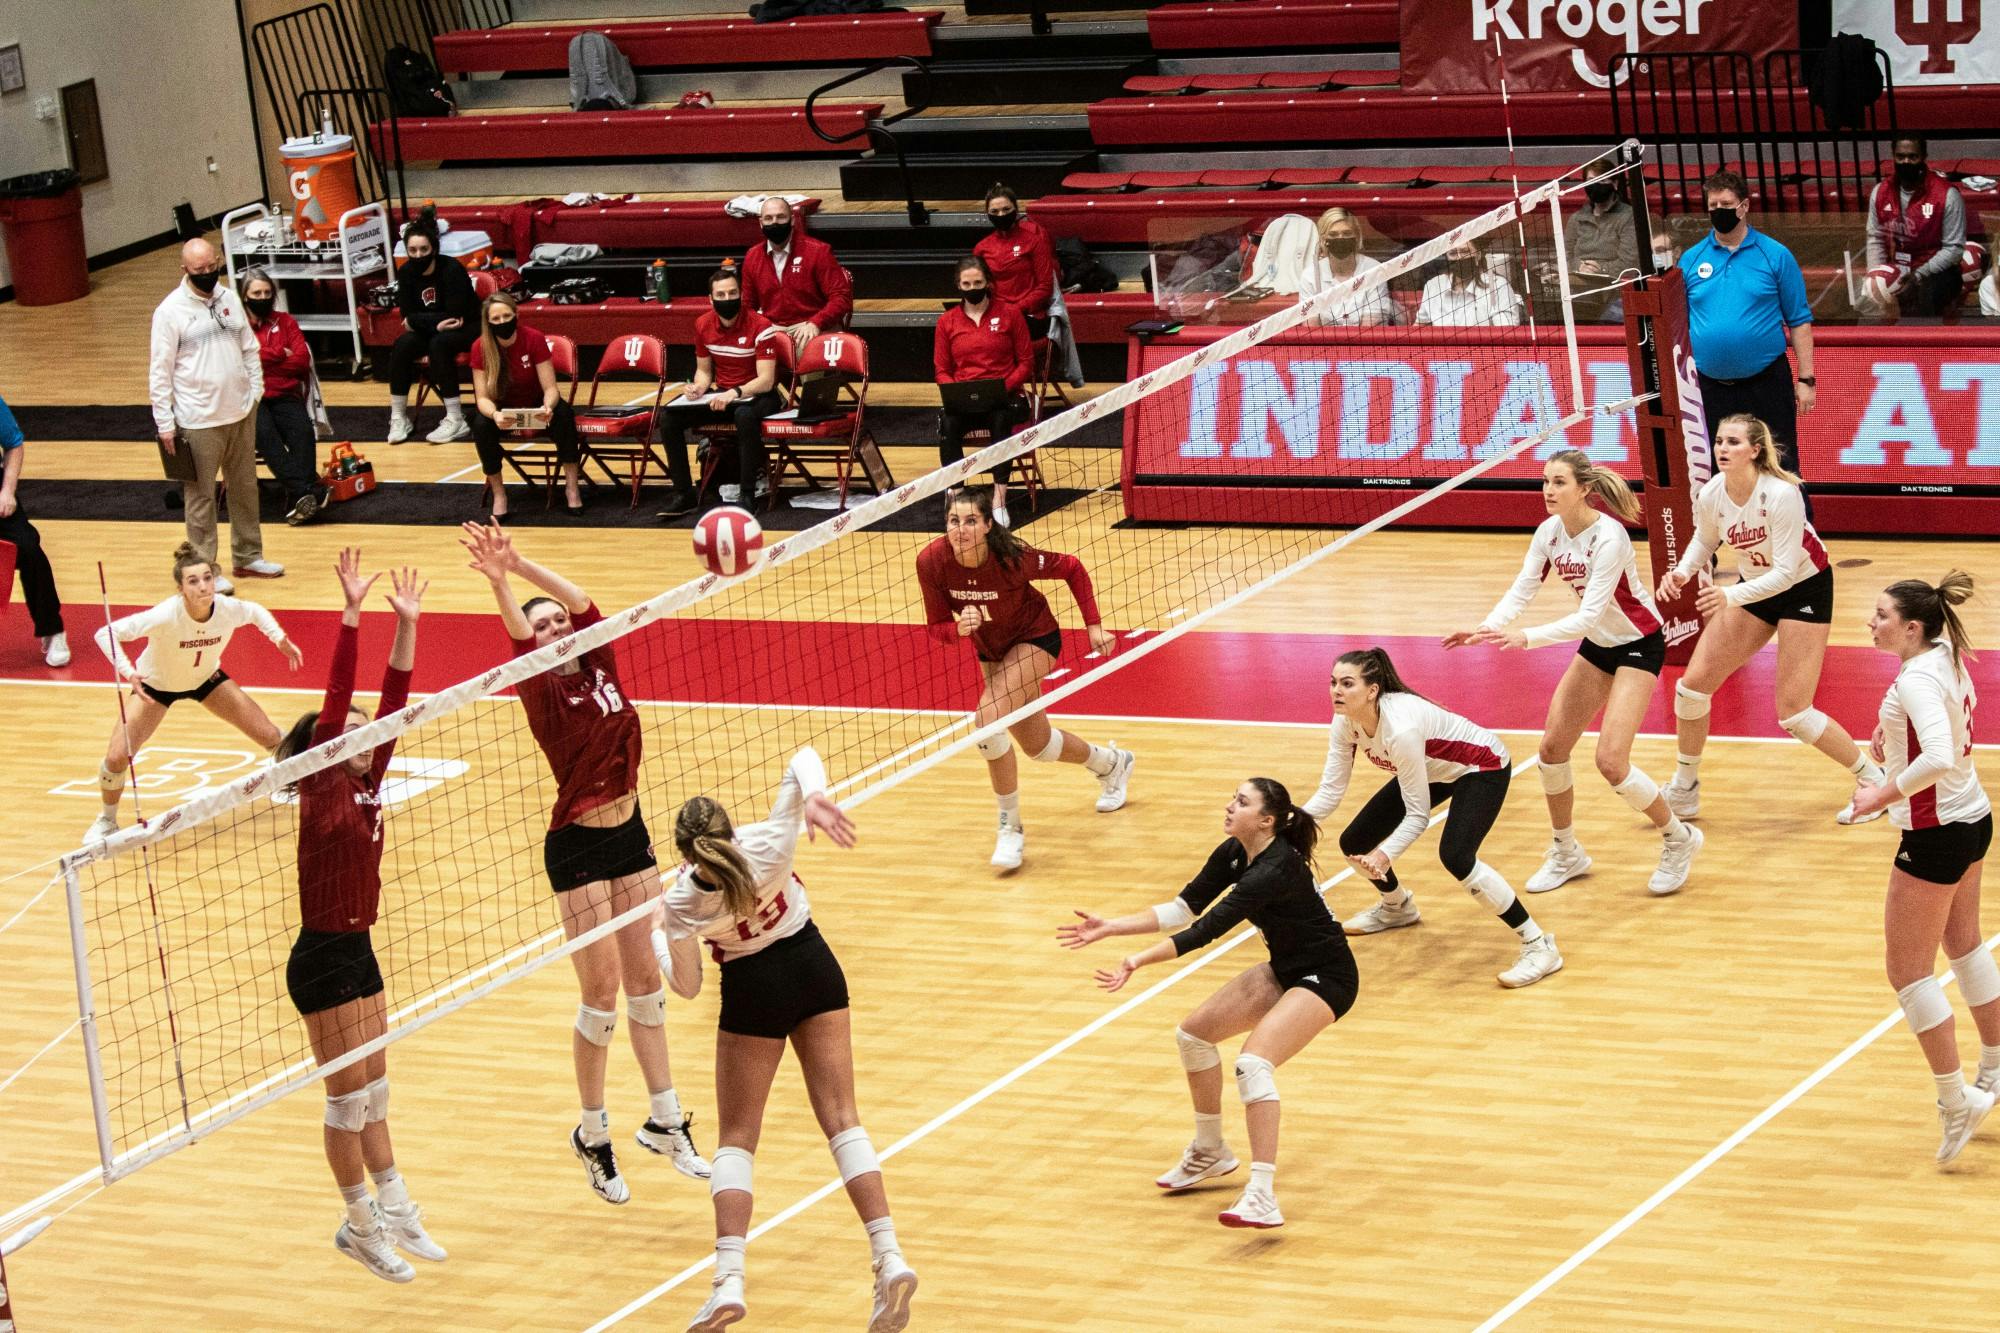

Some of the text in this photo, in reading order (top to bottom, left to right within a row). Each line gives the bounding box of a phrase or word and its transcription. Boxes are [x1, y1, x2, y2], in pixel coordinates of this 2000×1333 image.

[1472, 0, 1713, 88] Kroger
[290, 171, 311, 200] G
[348, 227, 381, 244] GATORADE
[1179, 360, 1640, 462] INDIAN
[355, 478, 365, 493] G
[1363, 477, 1411, 486] DAKTRONICS
[1901, 485, 1953, 493] DAKTRONICS
[1661, 507, 1676, 548] sports
[1727, 521, 1768, 549] Indiana
[949, 589, 999, 601] WISCONSIN
[179, 635, 222, 649] WISCONSIN
[1661, 616, 1700, 647] Indiana
[193, 650, 202, 668] 1
[591, 682, 623, 718] 16
